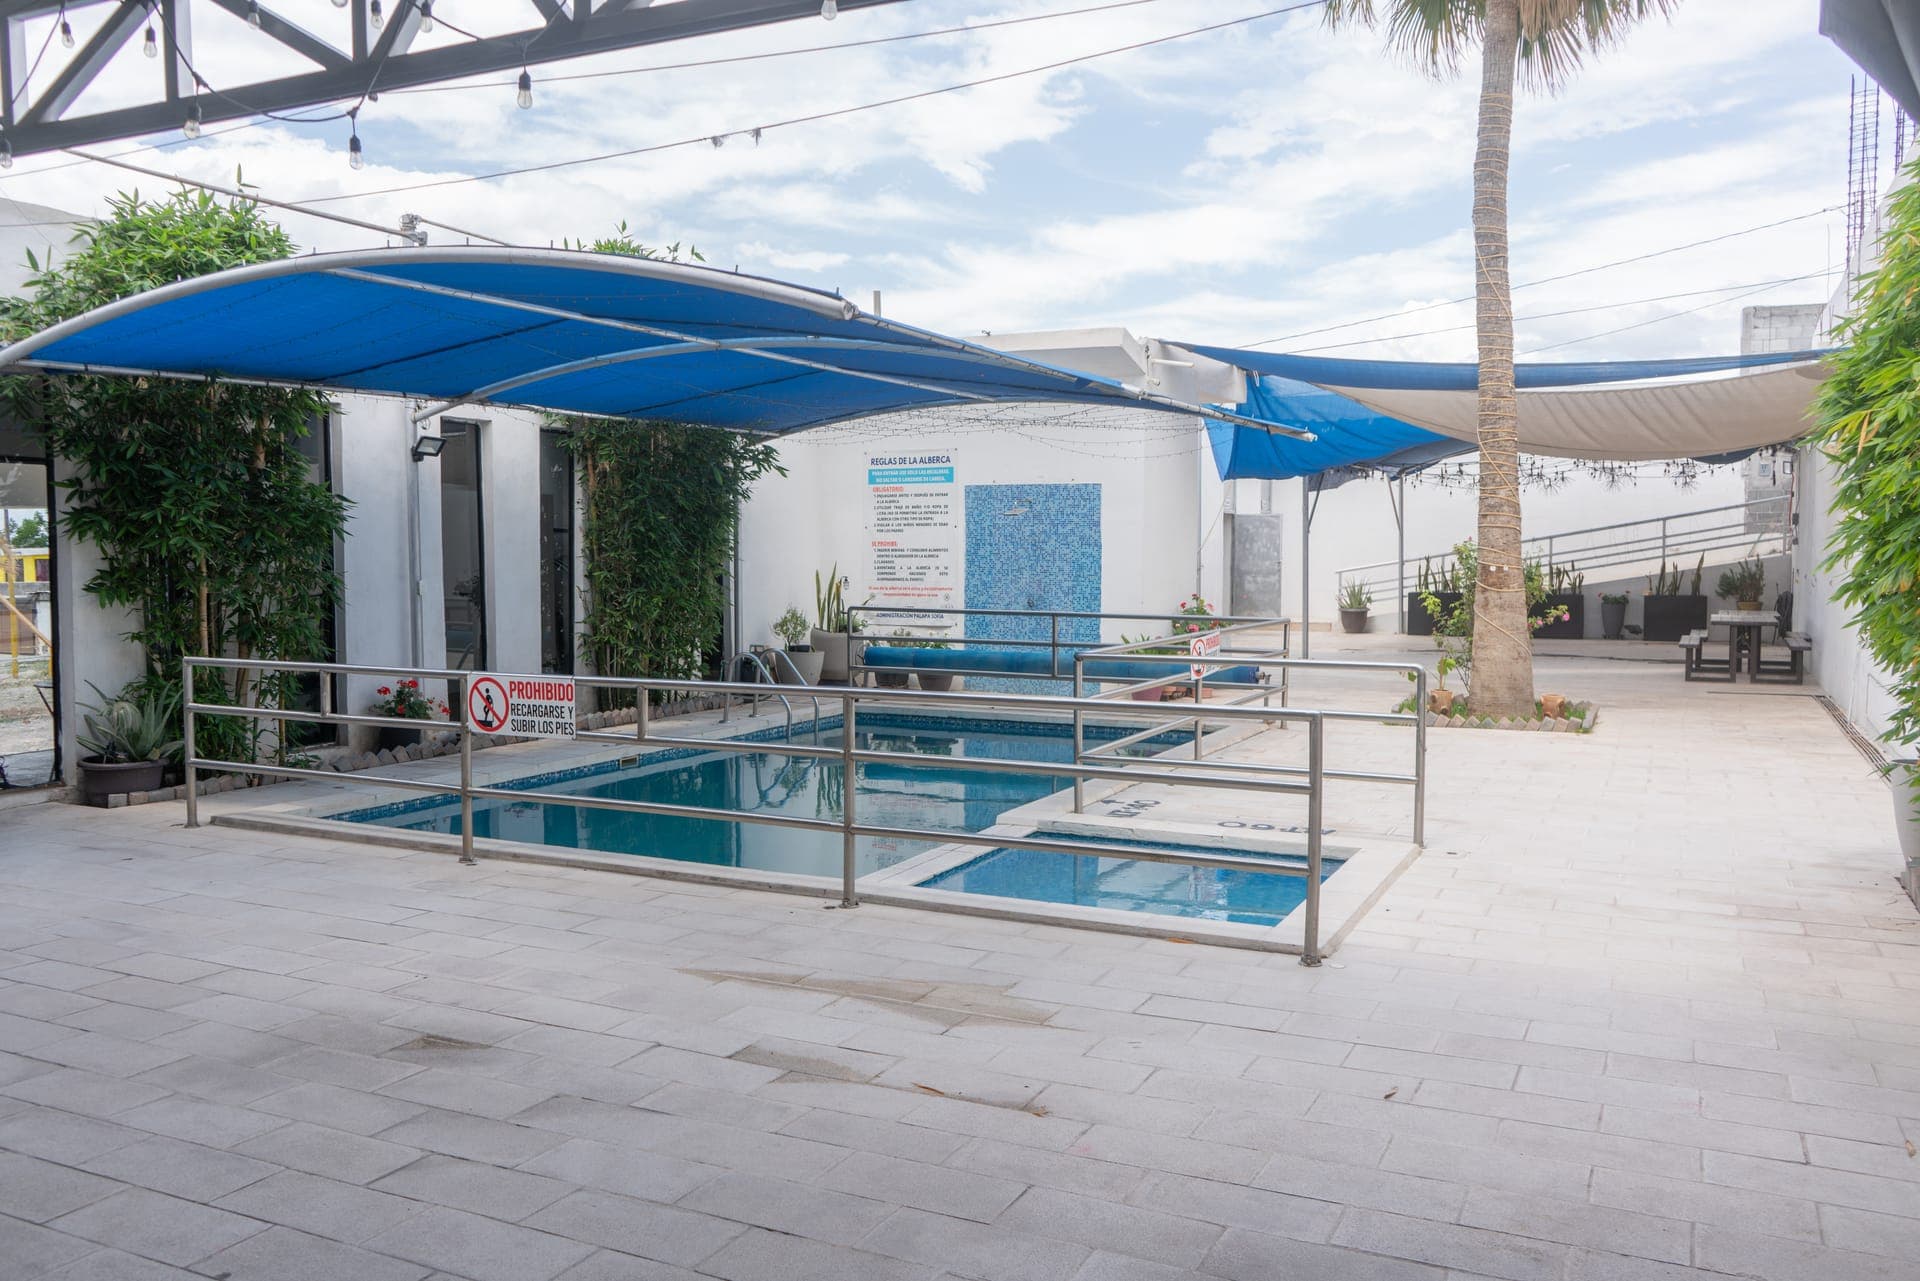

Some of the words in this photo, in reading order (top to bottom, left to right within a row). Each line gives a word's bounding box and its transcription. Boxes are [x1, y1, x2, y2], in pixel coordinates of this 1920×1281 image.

[509, 681, 573, 702] PROHIBIDO
[511, 703, 564, 719] RECARGARSE
[568, 707, 573, 719] Y
[512, 719, 536, 733] SUBIR
[538, 721, 553, 734] LOS
[556, 722, 574, 735] PIES
